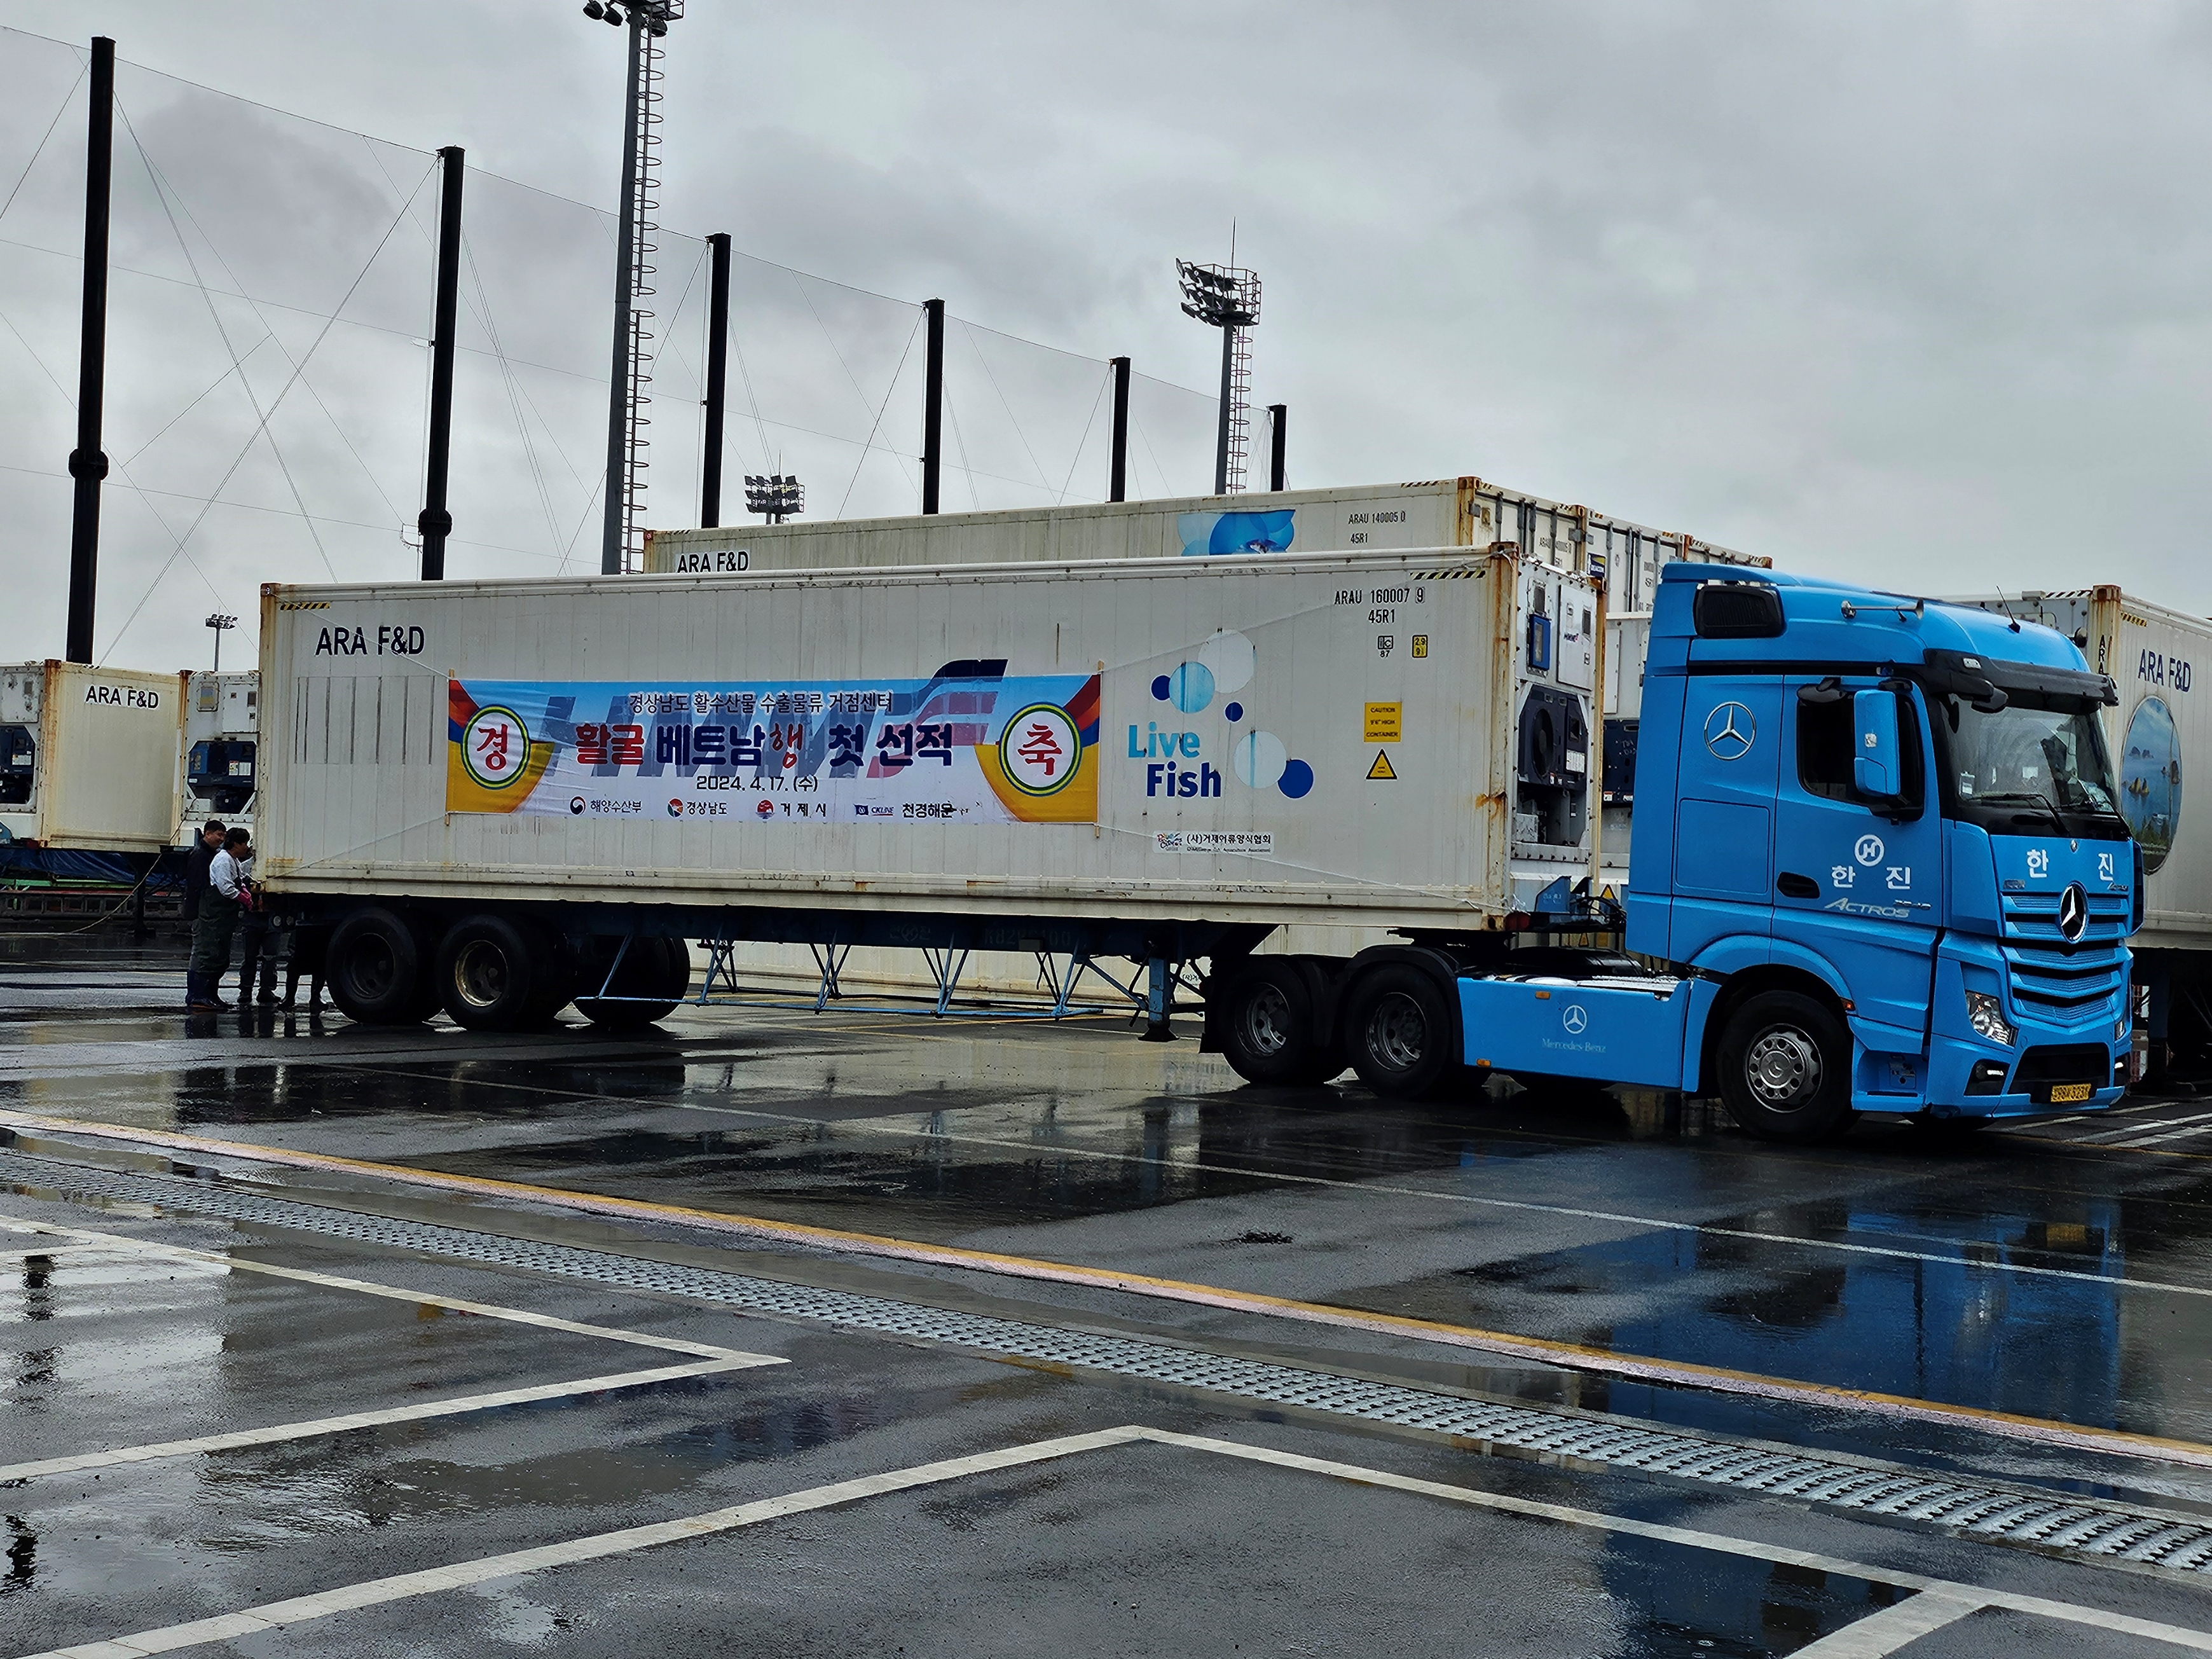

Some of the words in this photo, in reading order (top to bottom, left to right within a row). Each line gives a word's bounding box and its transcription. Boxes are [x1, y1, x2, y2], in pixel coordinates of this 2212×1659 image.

[1348, 513, 1369, 525] ARAU
[1350, 533, 1368, 544] 45R1
[677, 553, 711, 573] ARA
[717, 551, 749, 572] F&D
[1334, 589, 1362, 605] ARAU
[1370, 588, 1410, 603] 160007
[1416, 587, 1424, 603] 9
[1368, 609, 1395, 624] 45R1
[315, 626, 368, 656] ARA
[378, 626, 425, 656] F&D
[2138, 648, 2164, 686] ARA
[2169, 657, 2192, 692] F&D
[85, 685, 122, 706] ARA
[127, 690, 160, 709] F&D
[629, 692, 690, 713] 경상남도
[694, 692, 756, 713] 활수산물
[760, 692, 823, 713] 수출물류
[828, 692, 891, 713] 거점센터
[477, 723, 508, 771] 경
[575, 723, 645, 765] 활굴
[828, 724, 865, 767] 첫
[876, 723, 952, 766] 선적
[1017, 723, 1062, 776] 축
[1128, 721, 1200, 759] Live
[696, 776, 746, 791] 2024.
[793, 775, 818, 792] (수)
[1146, 761, 1222, 798] Fish
[590, 799, 642, 814] 해양수산부
[686, 801, 728, 816] 경상남도
[902, 802, 954, 818] 천경해운
[1824, 897, 1910, 918] ACTROS
